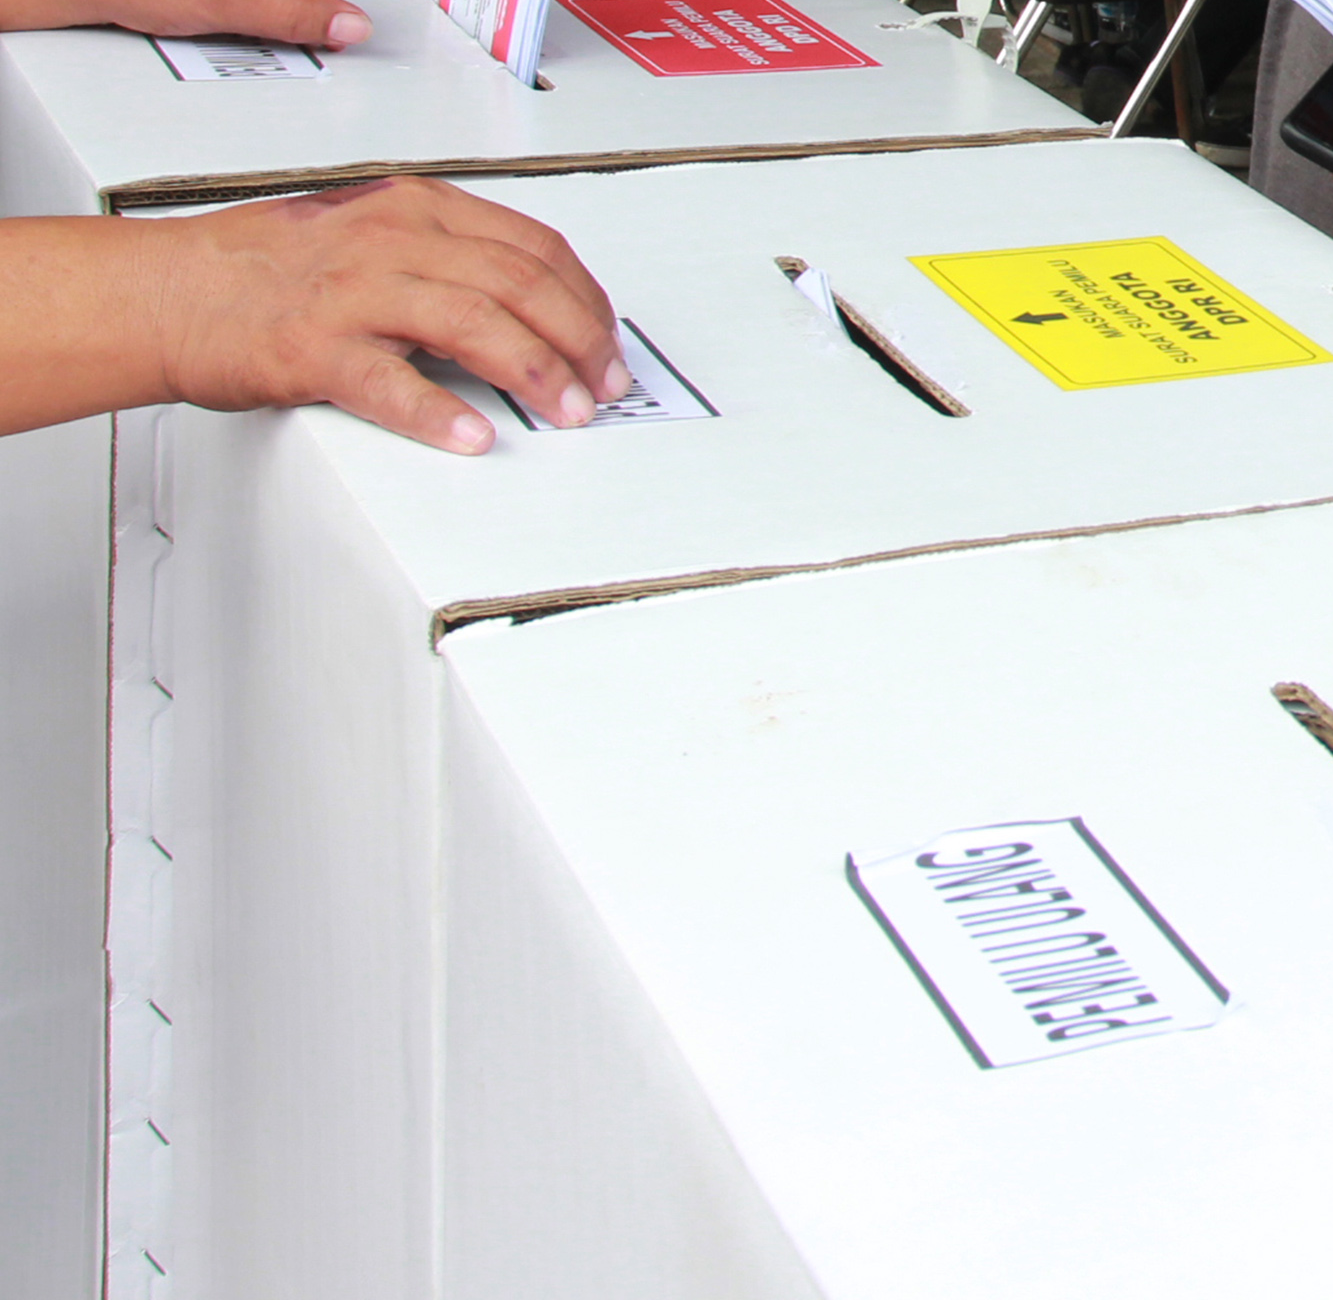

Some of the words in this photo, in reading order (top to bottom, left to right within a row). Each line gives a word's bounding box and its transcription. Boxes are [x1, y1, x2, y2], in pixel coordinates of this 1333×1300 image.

[665, 0, 710, 24] PEMILU
[756, 13, 790, 25] RI
[660, 17, 717, 50] MASUKAN
[697, 22, 740, 44] SUARA
[712, 9, 794, 53] ANGGOTA
[775, 24, 820, 44] DPD
[726, 44, 770, 66] SURAT
[1046, 259, 1107, 295] PEMILU
[1165, 277, 1204, 294] RI
[1047, 289, 1126, 339] MASUKAN
[1095, 294, 1152, 330] SUARA
[1108, 271, 1222, 341] ANGGOTA
[1190, 295, 1250, 326] DPR
[1139, 331, 1198, 364] SURAT
[914, 842, 1087, 938] ULANG
[981, 931, 1174, 1043] PEMILU
